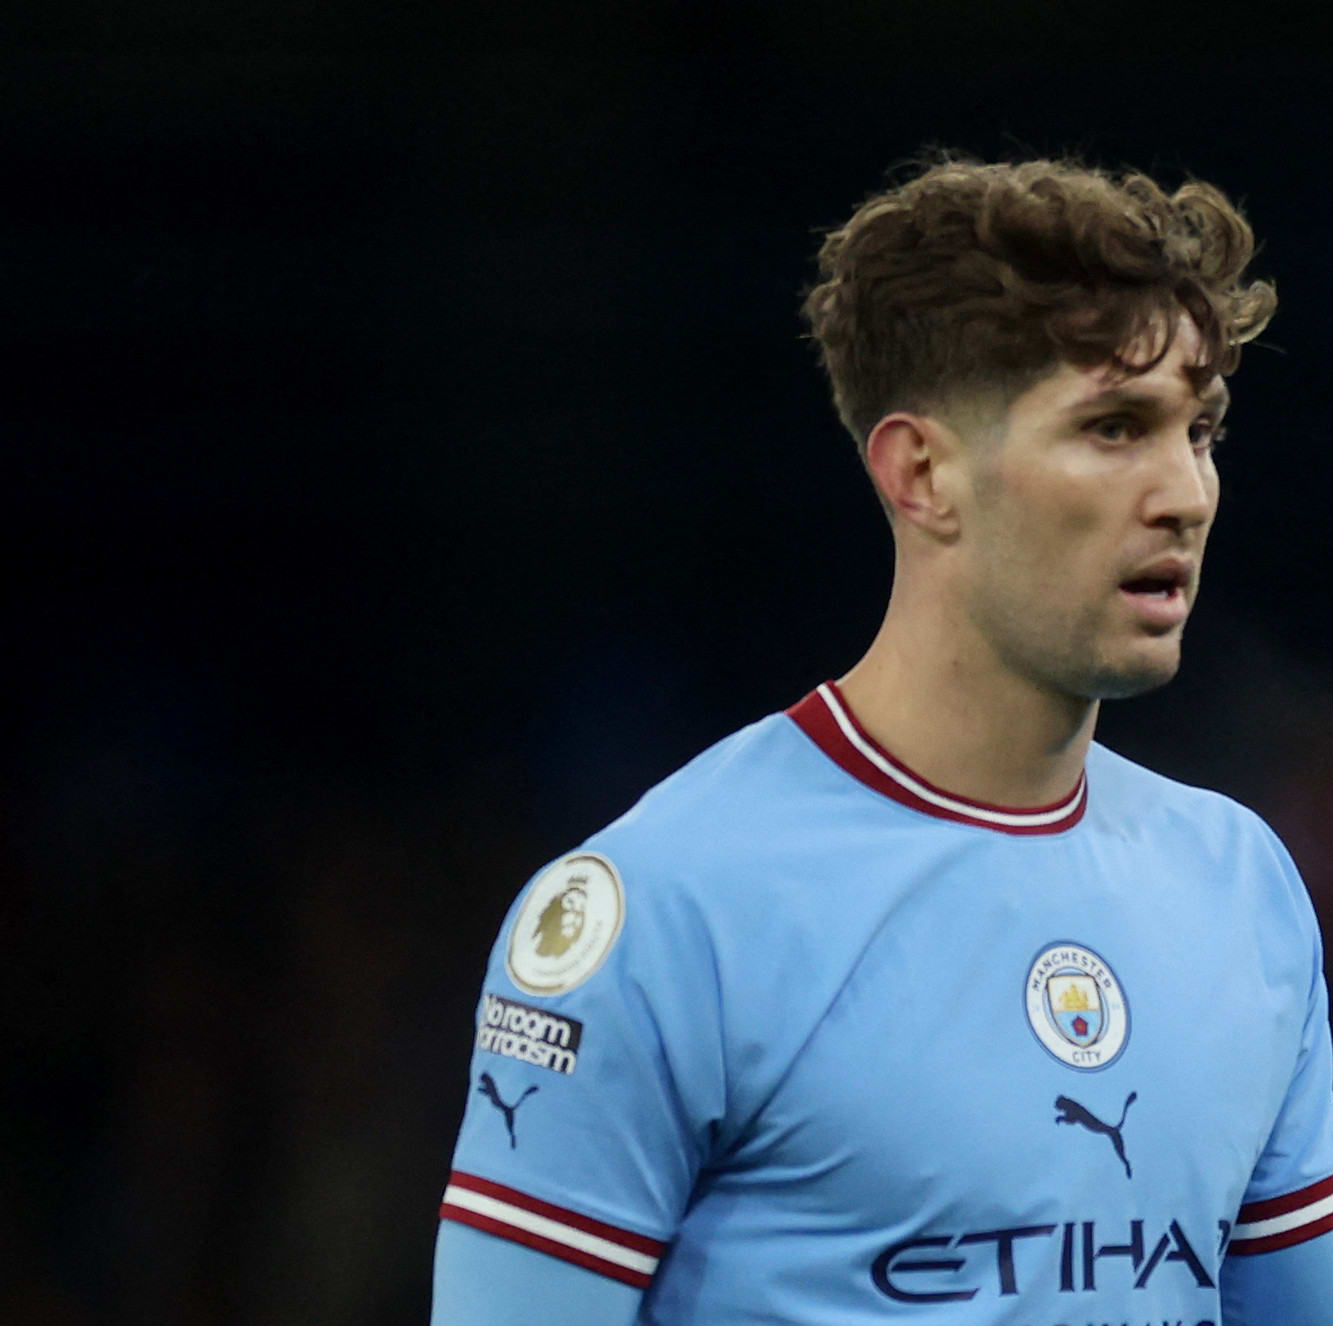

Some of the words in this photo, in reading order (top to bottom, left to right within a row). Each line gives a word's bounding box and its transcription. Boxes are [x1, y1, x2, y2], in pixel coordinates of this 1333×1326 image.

[1032, 951, 1112, 991] MANCHESTER
[503, 1005, 572, 1047] room
[1071, 1050, 1101, 1063] CITY
[870, 1218, 1231, 1305] ETIHA
